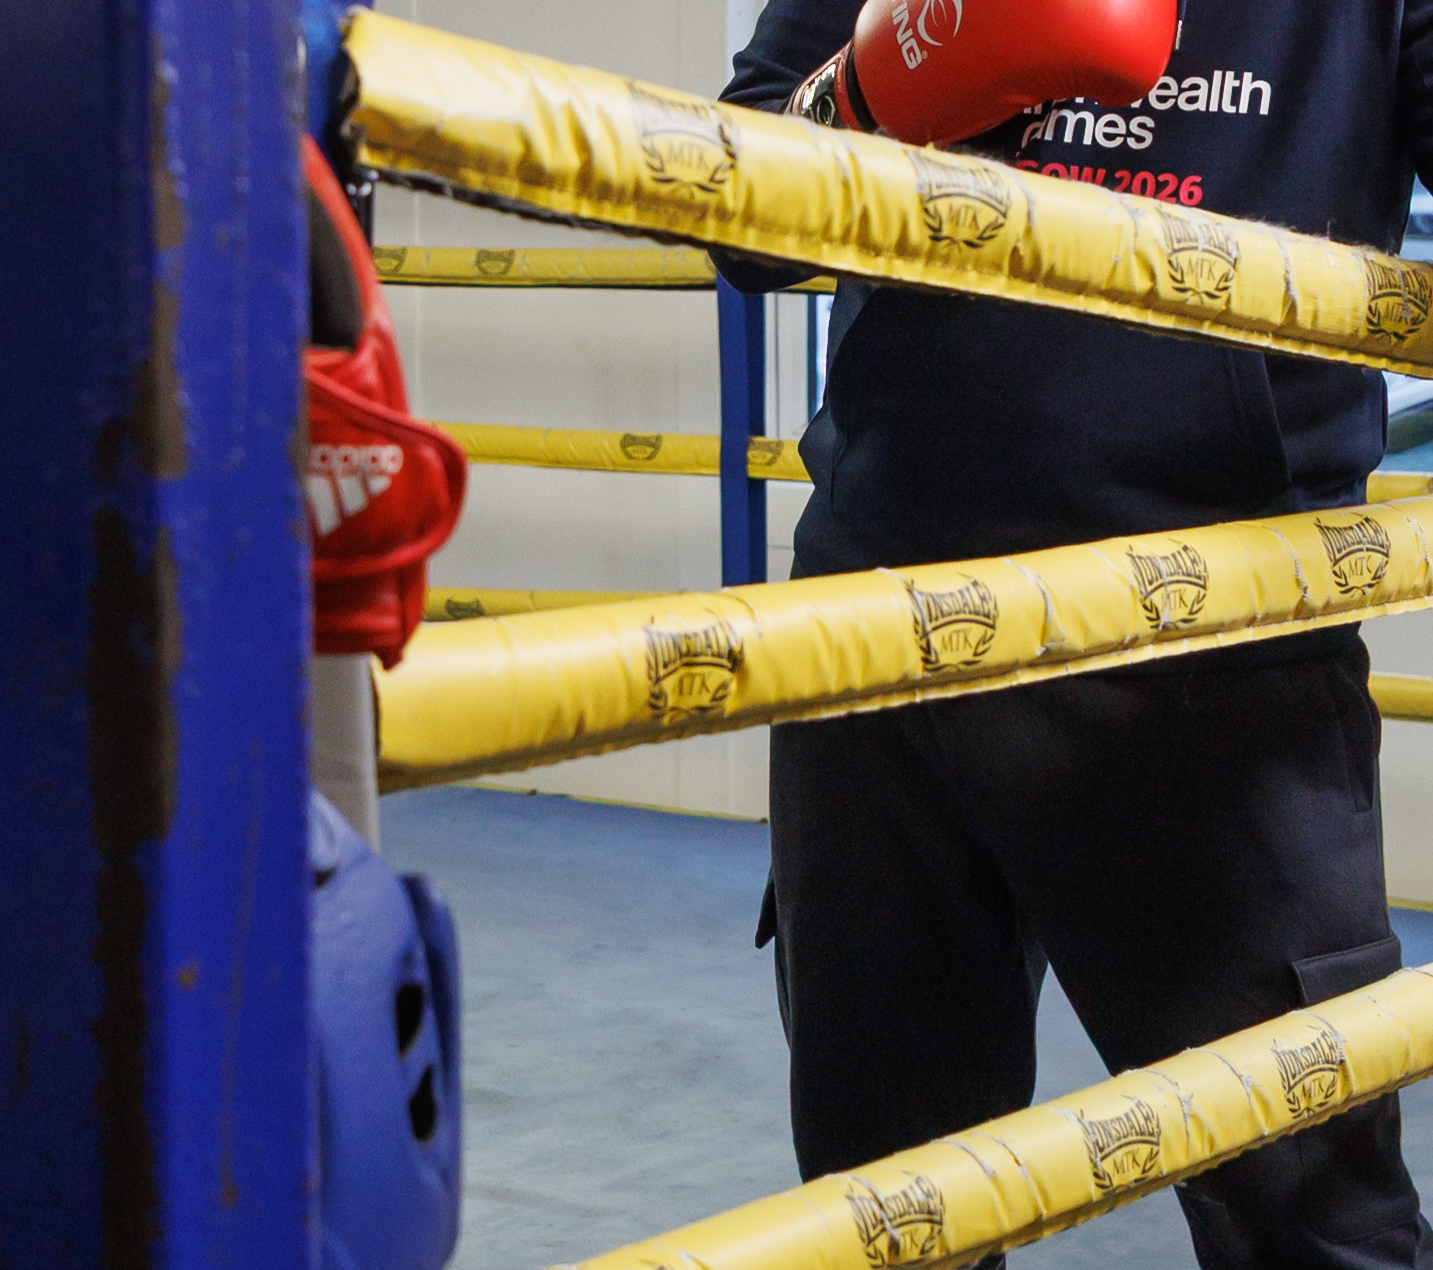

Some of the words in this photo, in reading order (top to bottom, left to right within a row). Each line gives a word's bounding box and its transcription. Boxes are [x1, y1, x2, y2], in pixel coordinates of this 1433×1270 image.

[1186, 256, 1216, 279] MTK
[1320, 517, 1390, 566] LONSDALE
[941, 626, 974, 653] MTK
[1083, 1100, 1160, 1160] LONSDALE
[1113, 1146, 1142, 1175] MTK
